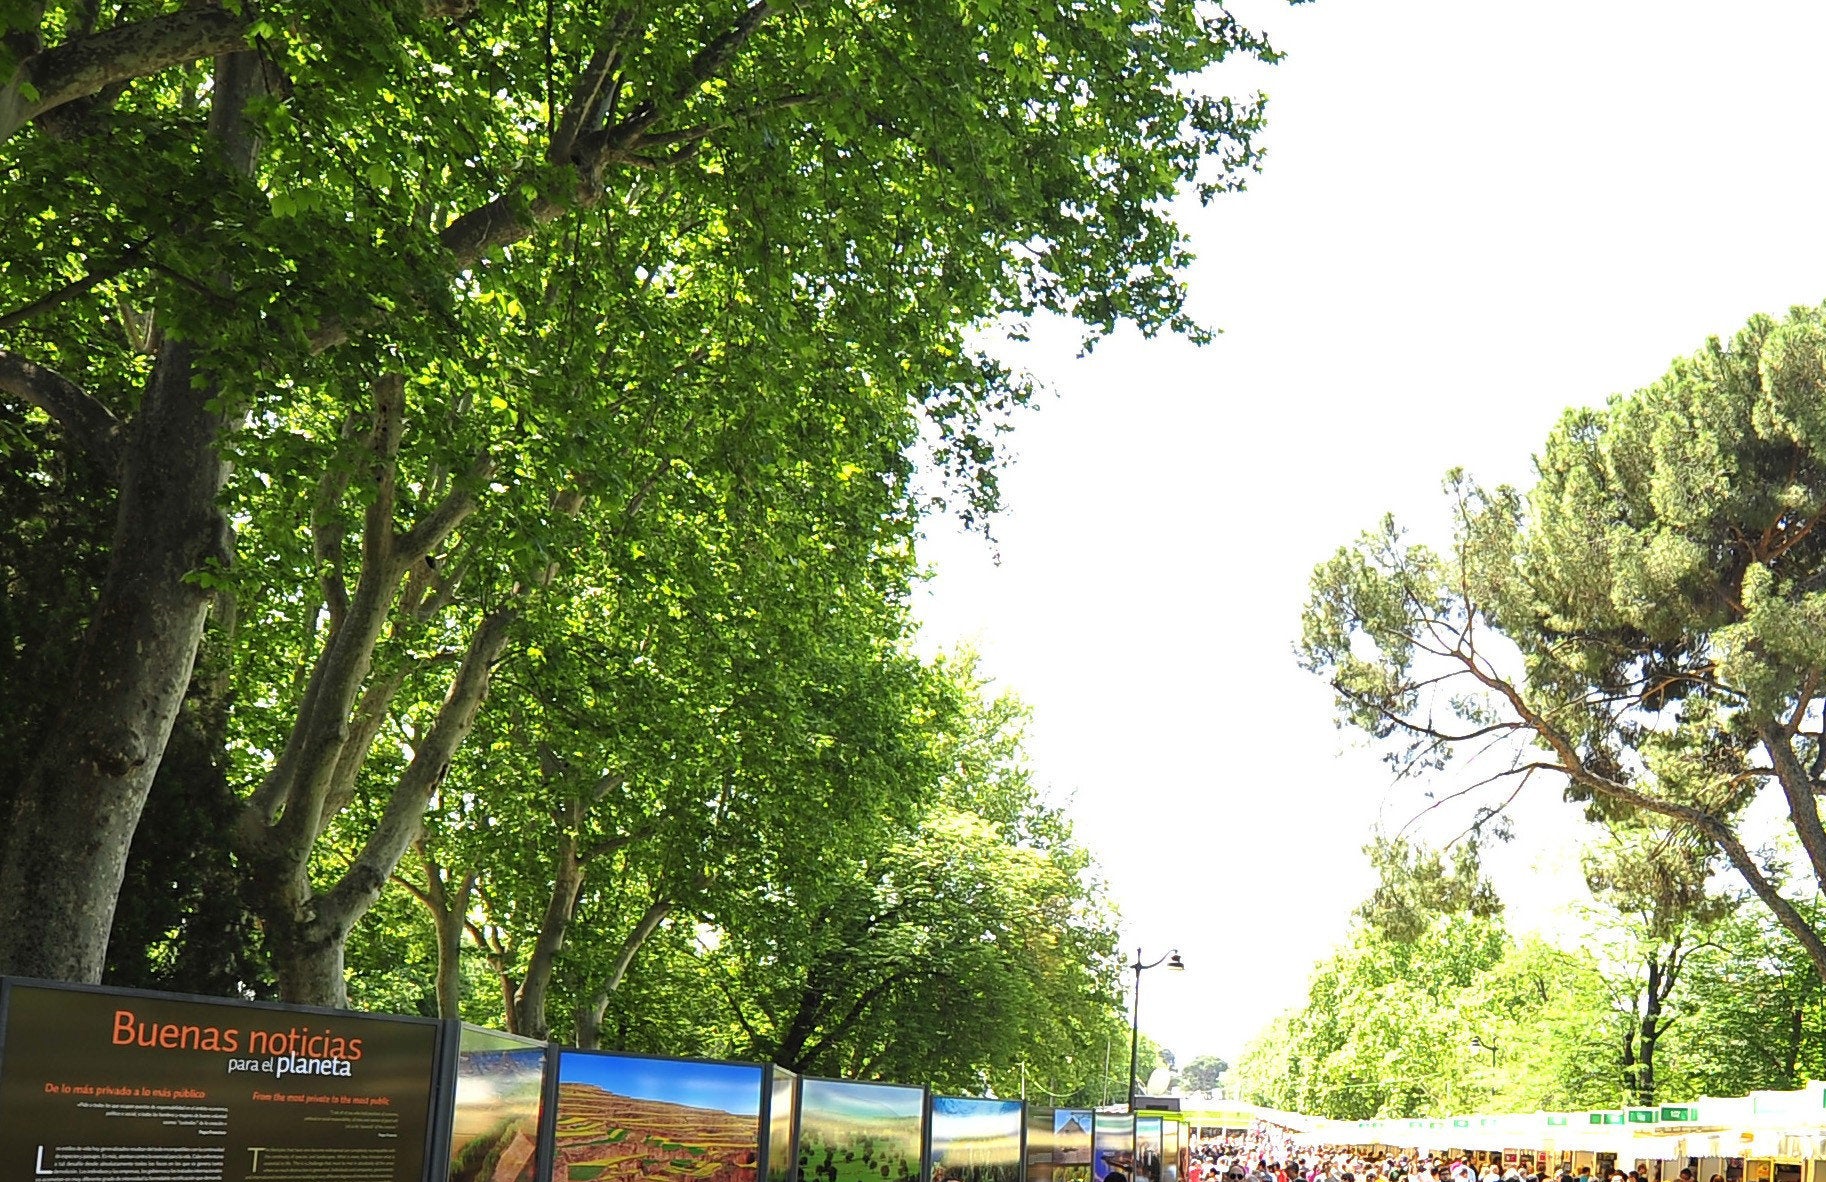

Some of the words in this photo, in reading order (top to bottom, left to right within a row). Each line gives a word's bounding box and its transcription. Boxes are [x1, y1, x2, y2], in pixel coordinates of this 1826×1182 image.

[111, 1009, 240, 1053] Buenas
[248, 1027, 363, 1061] noticias
[227, 1057, 260, 1074] para
[261, 1056, 274, 1073] el
[275, 1051, 352, 1079] planeta
[44, 1082, 60, 1094] De
[61, 1083, 72, 1094] lo
[73, 1084, 94, 1095] más
[95, 1085, 132, 1098] privado
[133, 1088, 140, 1097] a
[141, 1086, 151, 1097] lo
[152, 1087, 172, 1098] más
[172, 1087, 206, 1100] público
